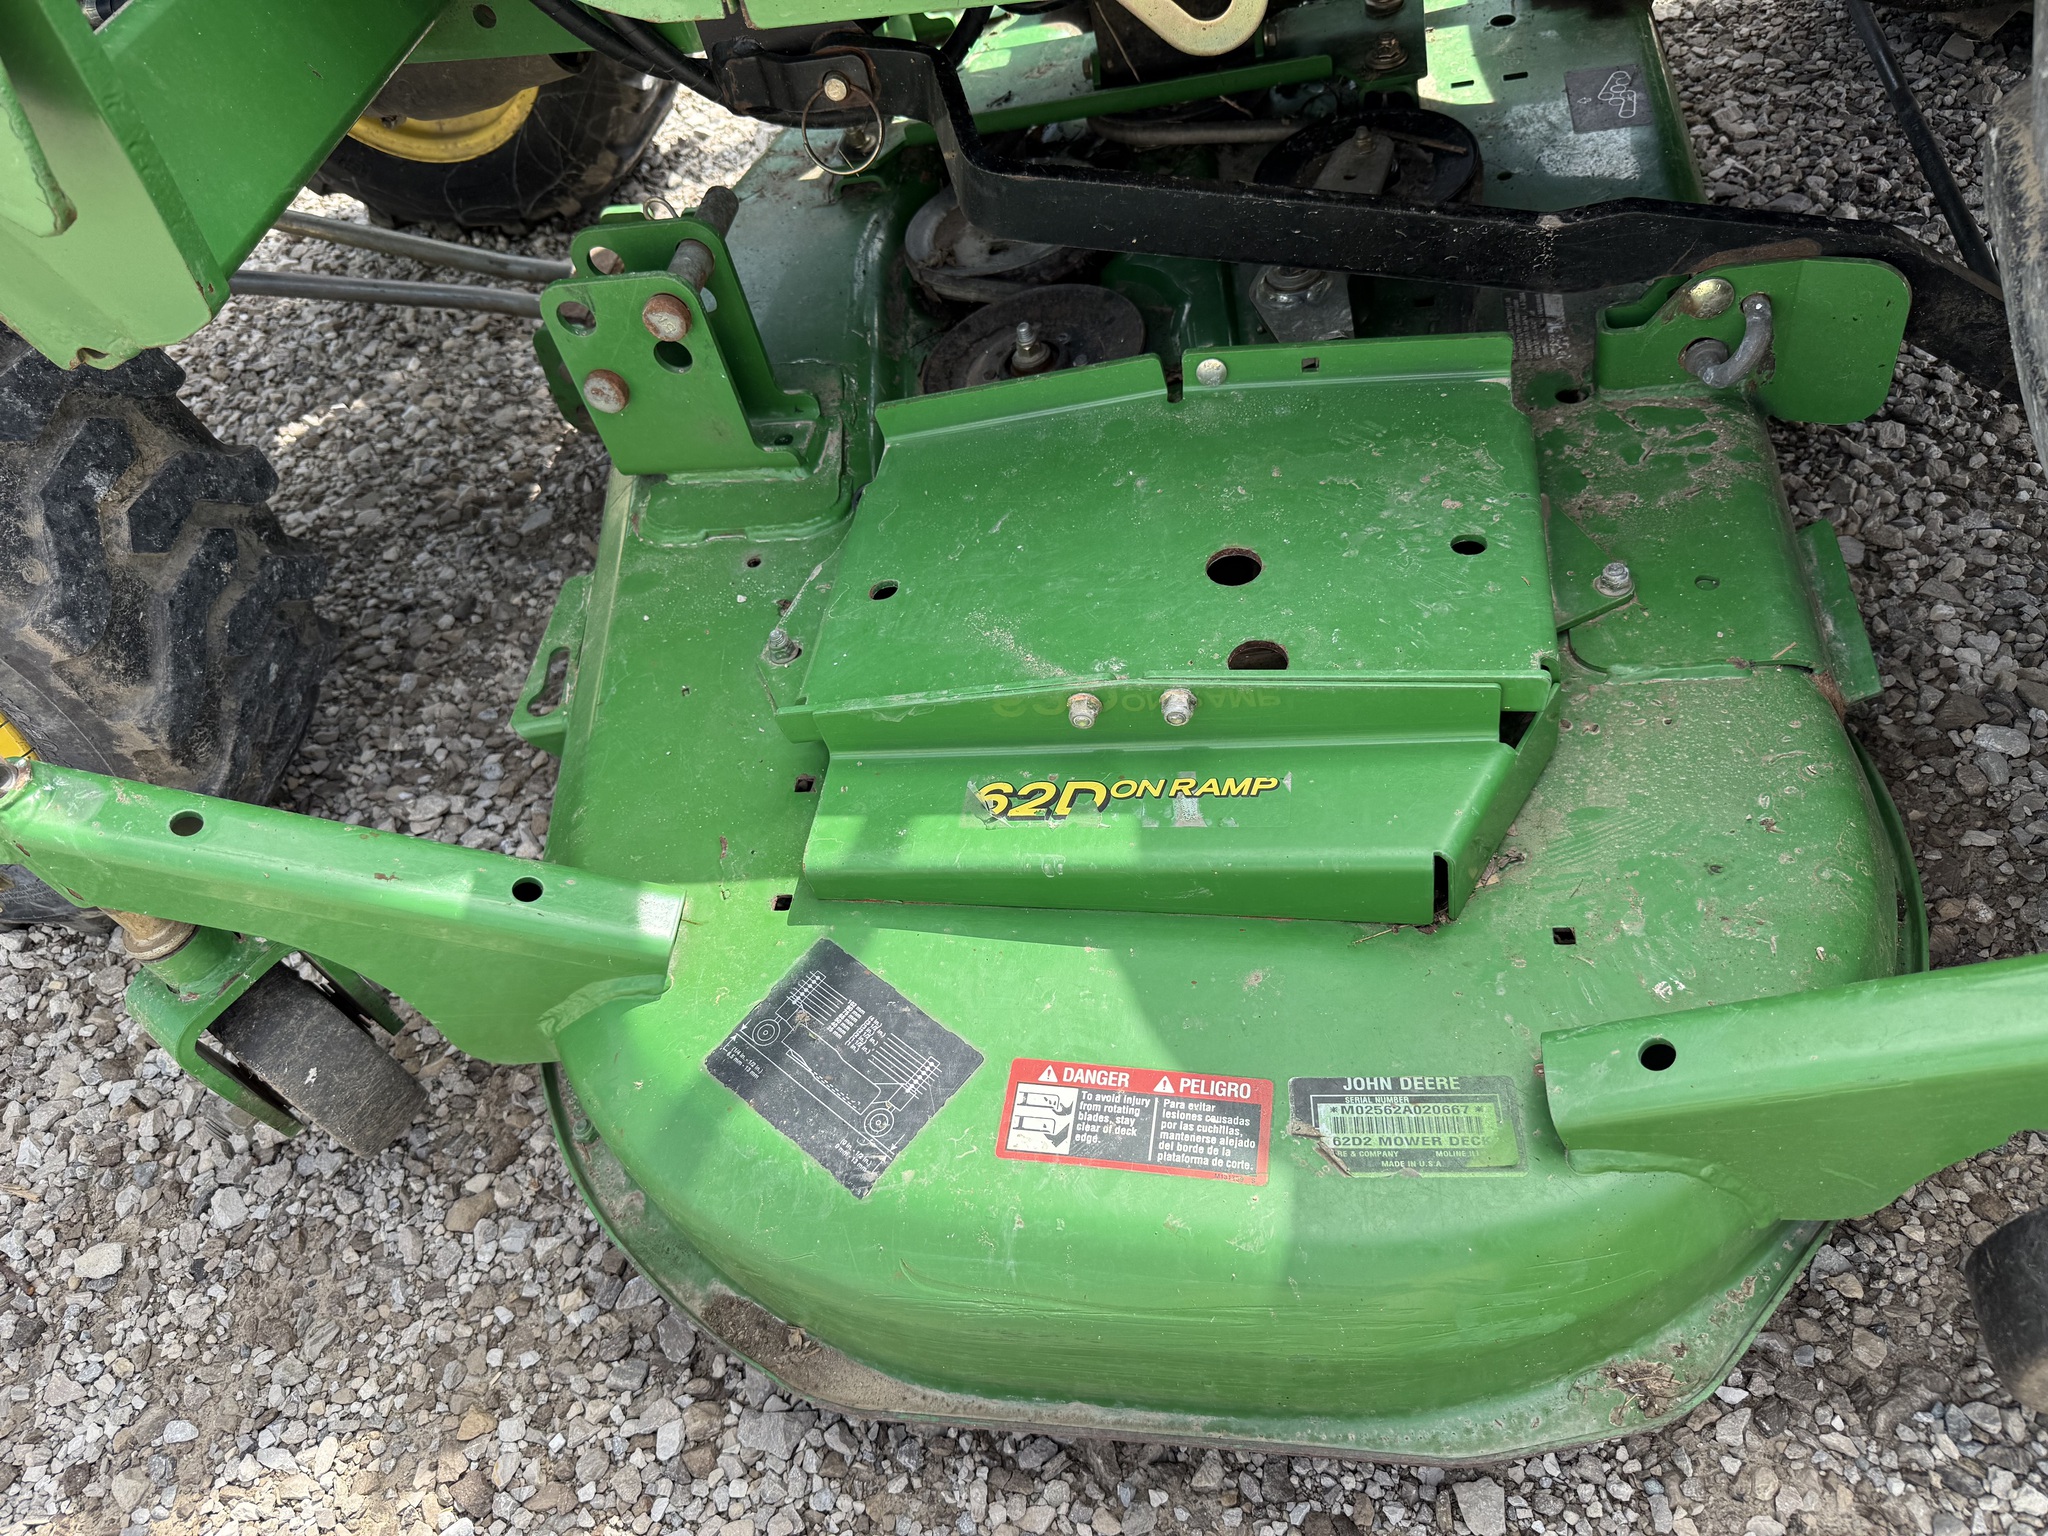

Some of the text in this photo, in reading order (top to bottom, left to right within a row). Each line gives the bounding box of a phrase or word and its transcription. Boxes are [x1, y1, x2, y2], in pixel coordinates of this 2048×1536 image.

[1110, 778, 1167, 800] ON
[1168, 777, 1280, 798] RAMP
[1062, 1067, 1130, 1088] DANGER
[1342, 1076, 1460, 1091] JOHN DEERE
[1179, 1077, 1251, 1099] PELIGRO
[1081, 1091, 1151, 1107] To avoid injury
[1163, 1098, 1216, 1112] Para evitar
[1345, 1096, 1410, 1104] SERIAL NUMBER
[1080, 1102, 1141, 1117] from rotating
[1078, 1112, 1135, 1127] blades, stay
[1162, 1109, 1251, 1126] lesiones causadas
[1076, 1122, 1137, 1136] clear of deck
[1160, 1121, 1243, 1137] por las cuchillas,
[1075, 1133, 1101, 1145] edge.
[1159, 1131, 1256, 1150] mantenerse alejado
[1333, 1135, 1491, 1146] 62D2 MOWER DECK
[1158, 1141, 1231, 1156] del borde de la
[1157, 1151, 1254, 1170] plataforma de corte.
[1381, 1160, 1405, 1168] MADE
[1407, 1160, 1417, 1168] IN
